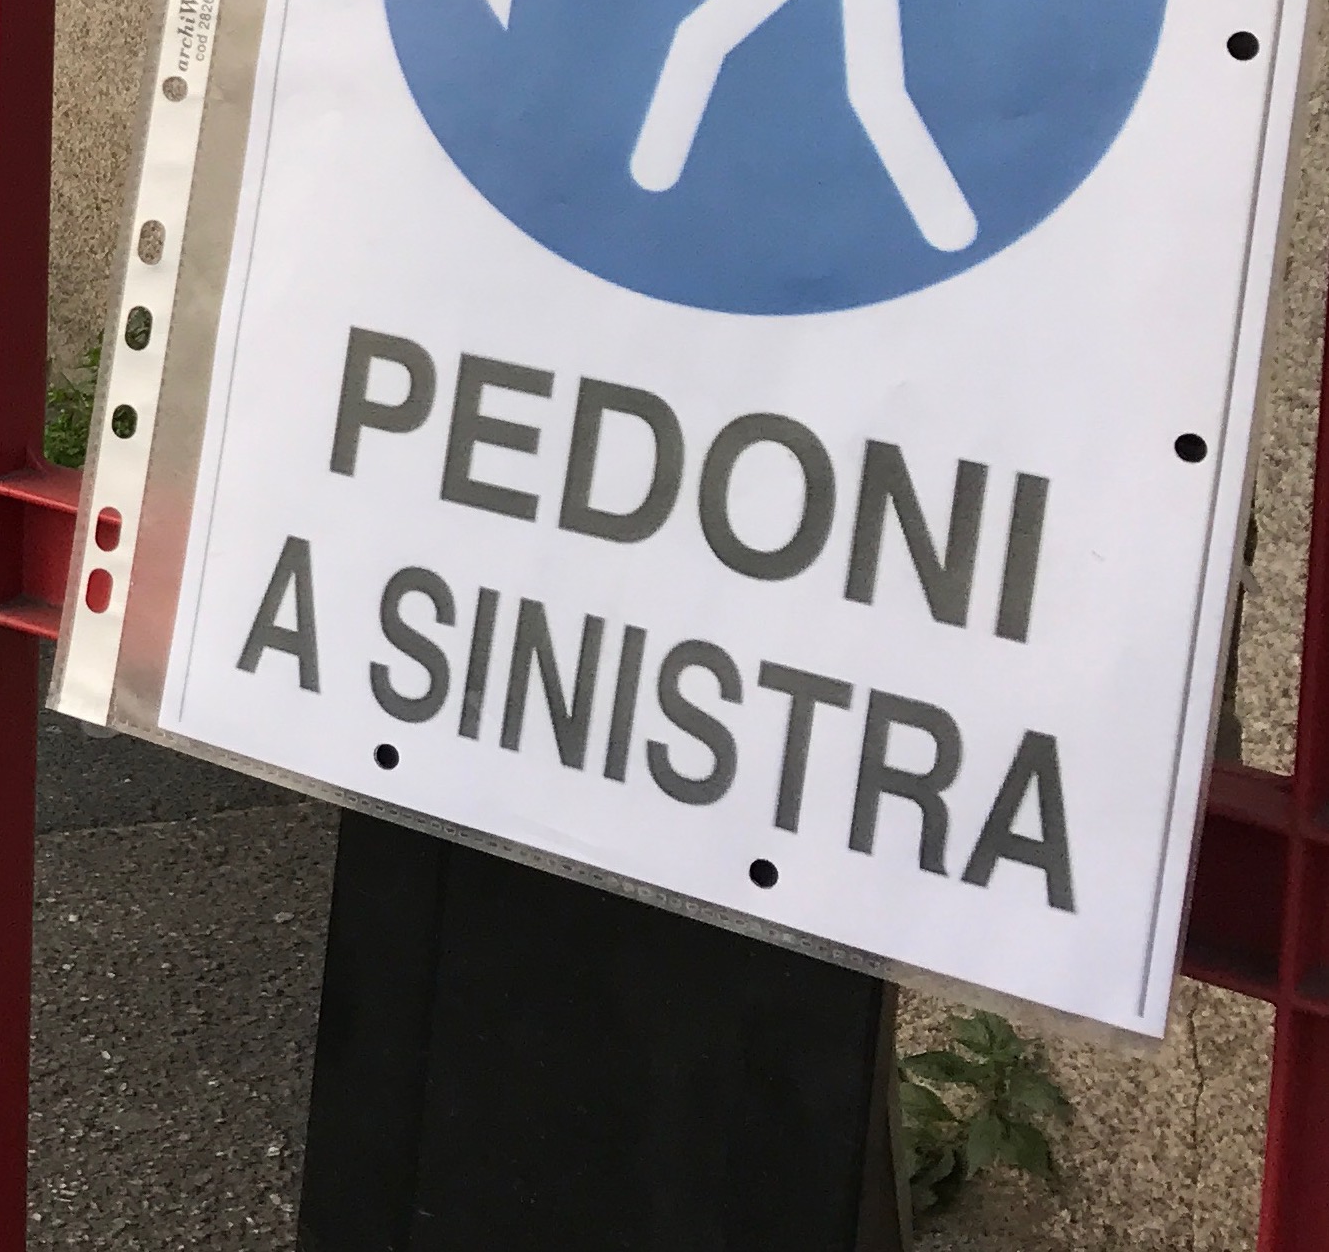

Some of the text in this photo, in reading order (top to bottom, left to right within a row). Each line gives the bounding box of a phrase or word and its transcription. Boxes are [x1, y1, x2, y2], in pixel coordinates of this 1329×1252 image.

[195, 33, 209, 62] cod
[329, 326, 1050, 644] PEDONI
[236, 535, 1076, 913] A SINISTRA
